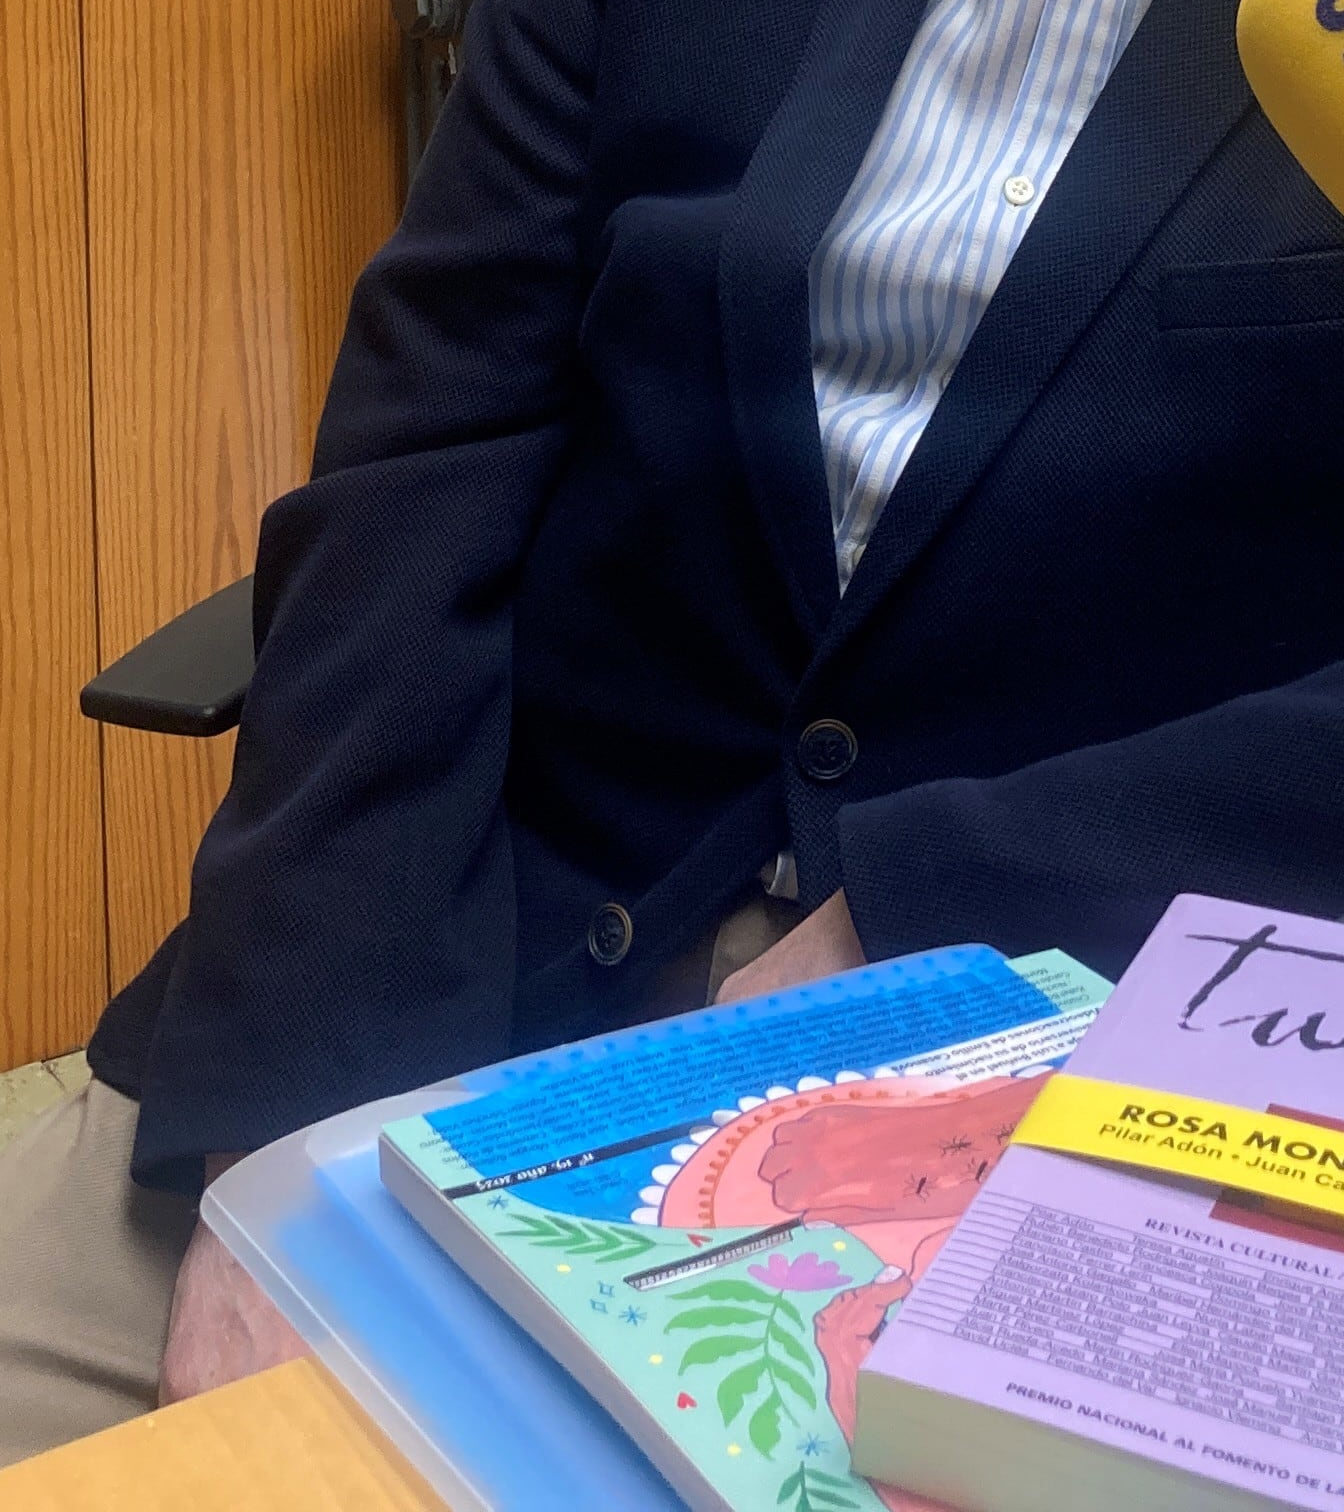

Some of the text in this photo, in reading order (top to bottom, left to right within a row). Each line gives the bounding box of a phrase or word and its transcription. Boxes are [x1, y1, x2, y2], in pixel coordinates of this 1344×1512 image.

[1099, 1123, 1155, 1145] Pilar
[1158, 1135, 1223, 1160] Adón
[1245, 1155, 1307, 1181] Juan
[1118, 1104, 1228, 1141] ROSA
[1145, 1218, 1224, 1250] REVISTA
[1231, 1242, 1333, 1278] CULTURAL
[1006, 1382, 1073, 1410] PREMIO
[1077, 1404, 1168, 1442] NACIONAL
[1173, 1437, 1196, 1452] AL
[1202, 1444, 1290, 1479] FOMENTO
[1296, 1473, 1321, 1489] DE
